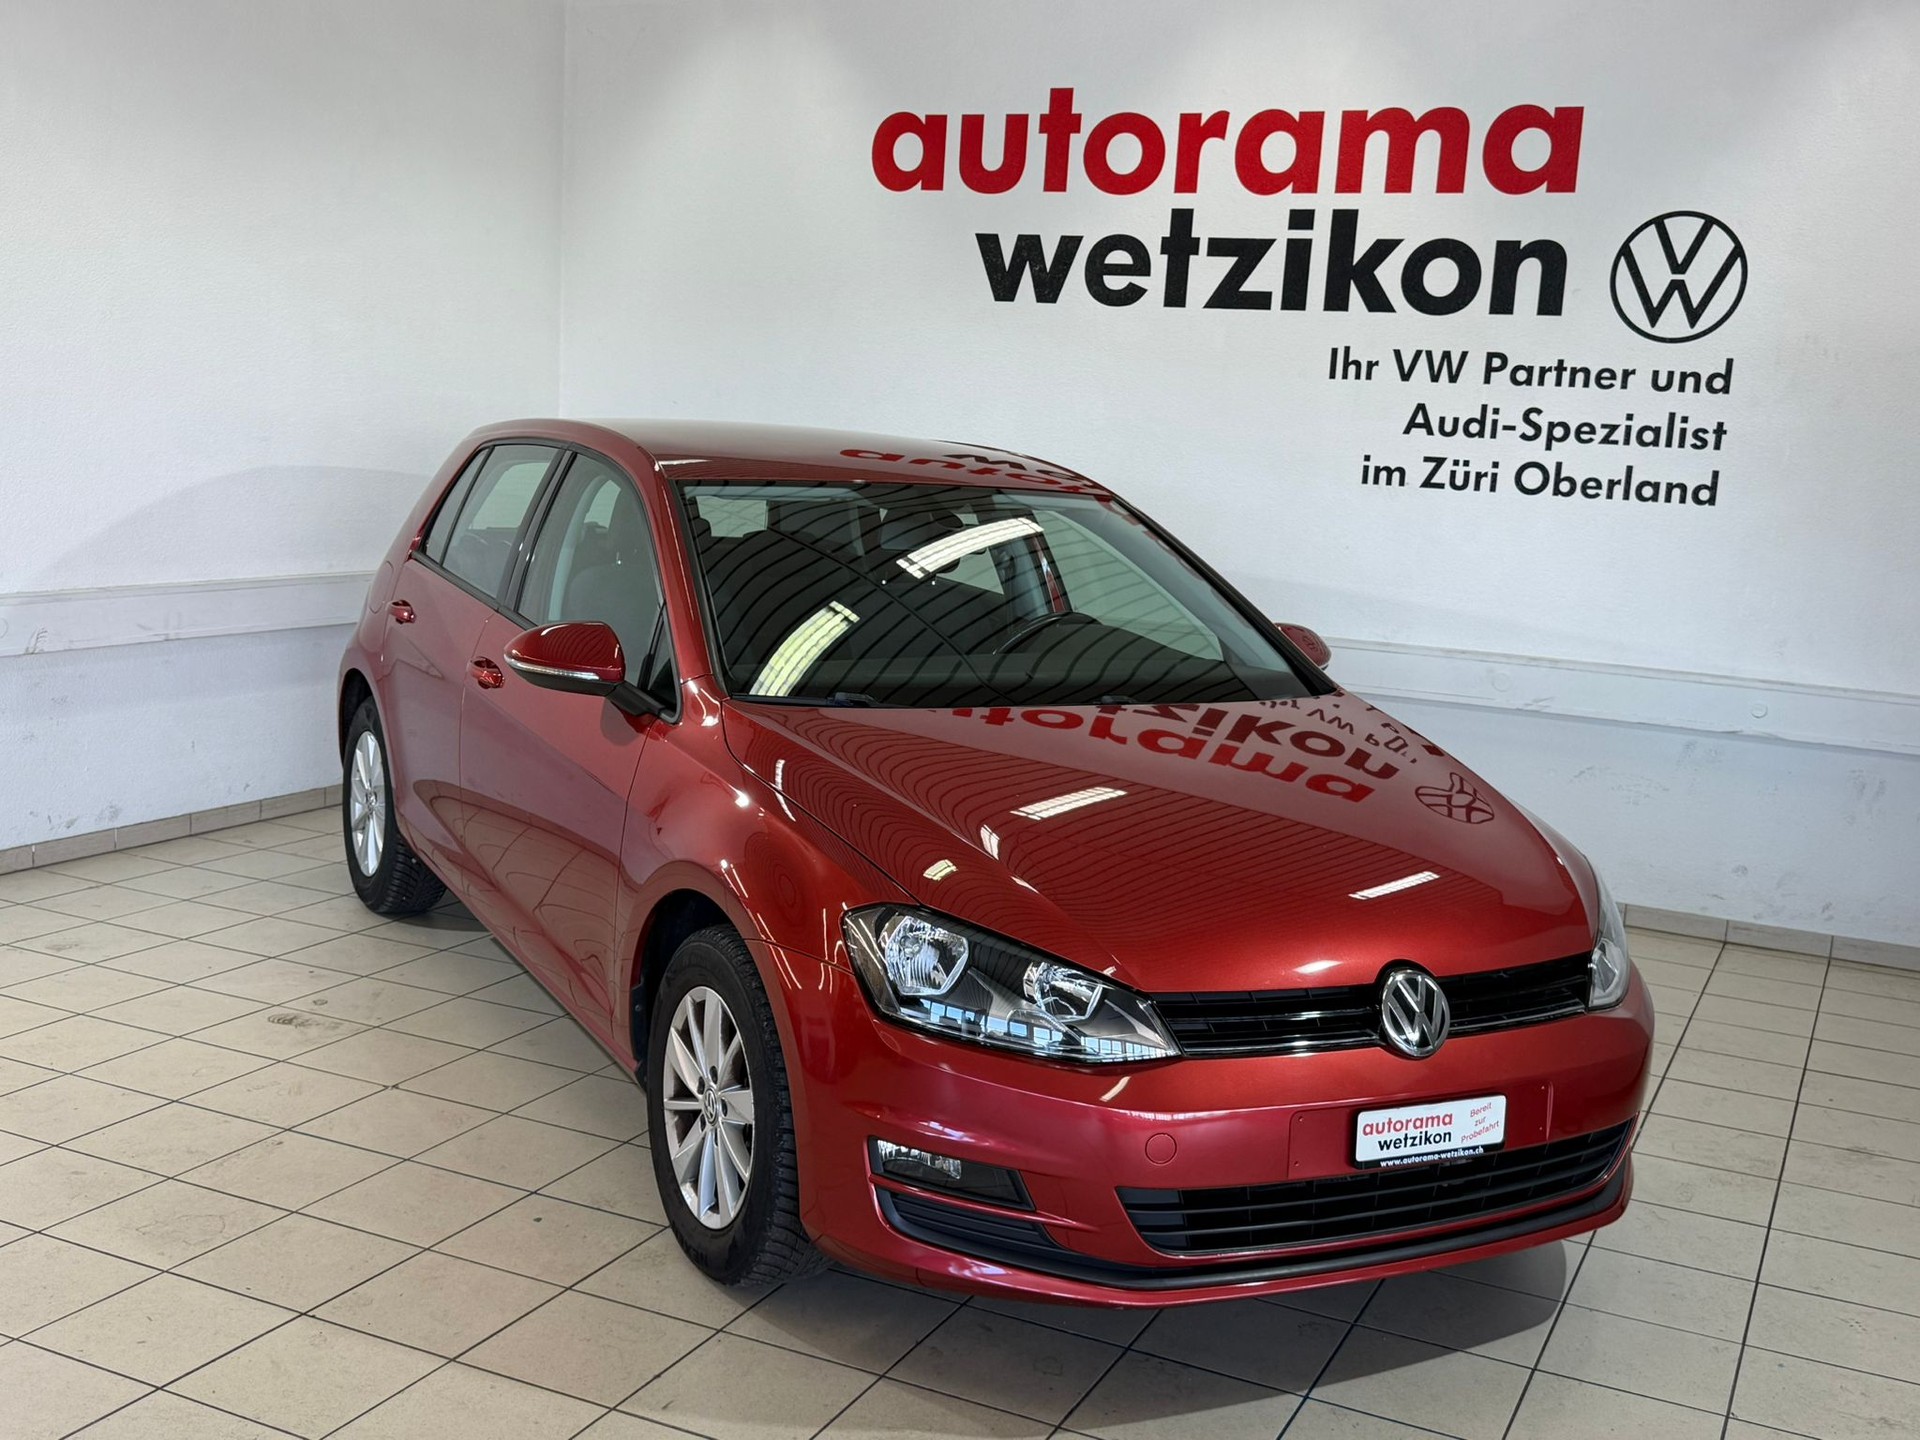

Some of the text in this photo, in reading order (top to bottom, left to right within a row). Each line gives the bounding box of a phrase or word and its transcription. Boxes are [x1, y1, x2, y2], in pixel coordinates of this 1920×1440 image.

[872, 88, 1585, 197] autorama
[974, 208, 1568, 317] wetzikon
[1610, 211, 1748, 343] VW
[1328, 345, 1734, 395] Ihr VW Partner und
[1402, 402, 1728, 452] Audi-Spezialist
[1361, 454, 1720, 507] im Züri Oberland
[1382, 969, 1451, 1056] VW
[1362, 1113, 1453, 1137] autorama
[1460, 1120, 1500, 1144] Probefahrt
[1470, 1102, 1492, 1118] Bereit
[1474, 1116, 1486, 1127] zur
[1378, 1130, 1452, 1151] wetzikon
[1380, 1145, 1484, 1168] www.autorama-wetzikon.ch
